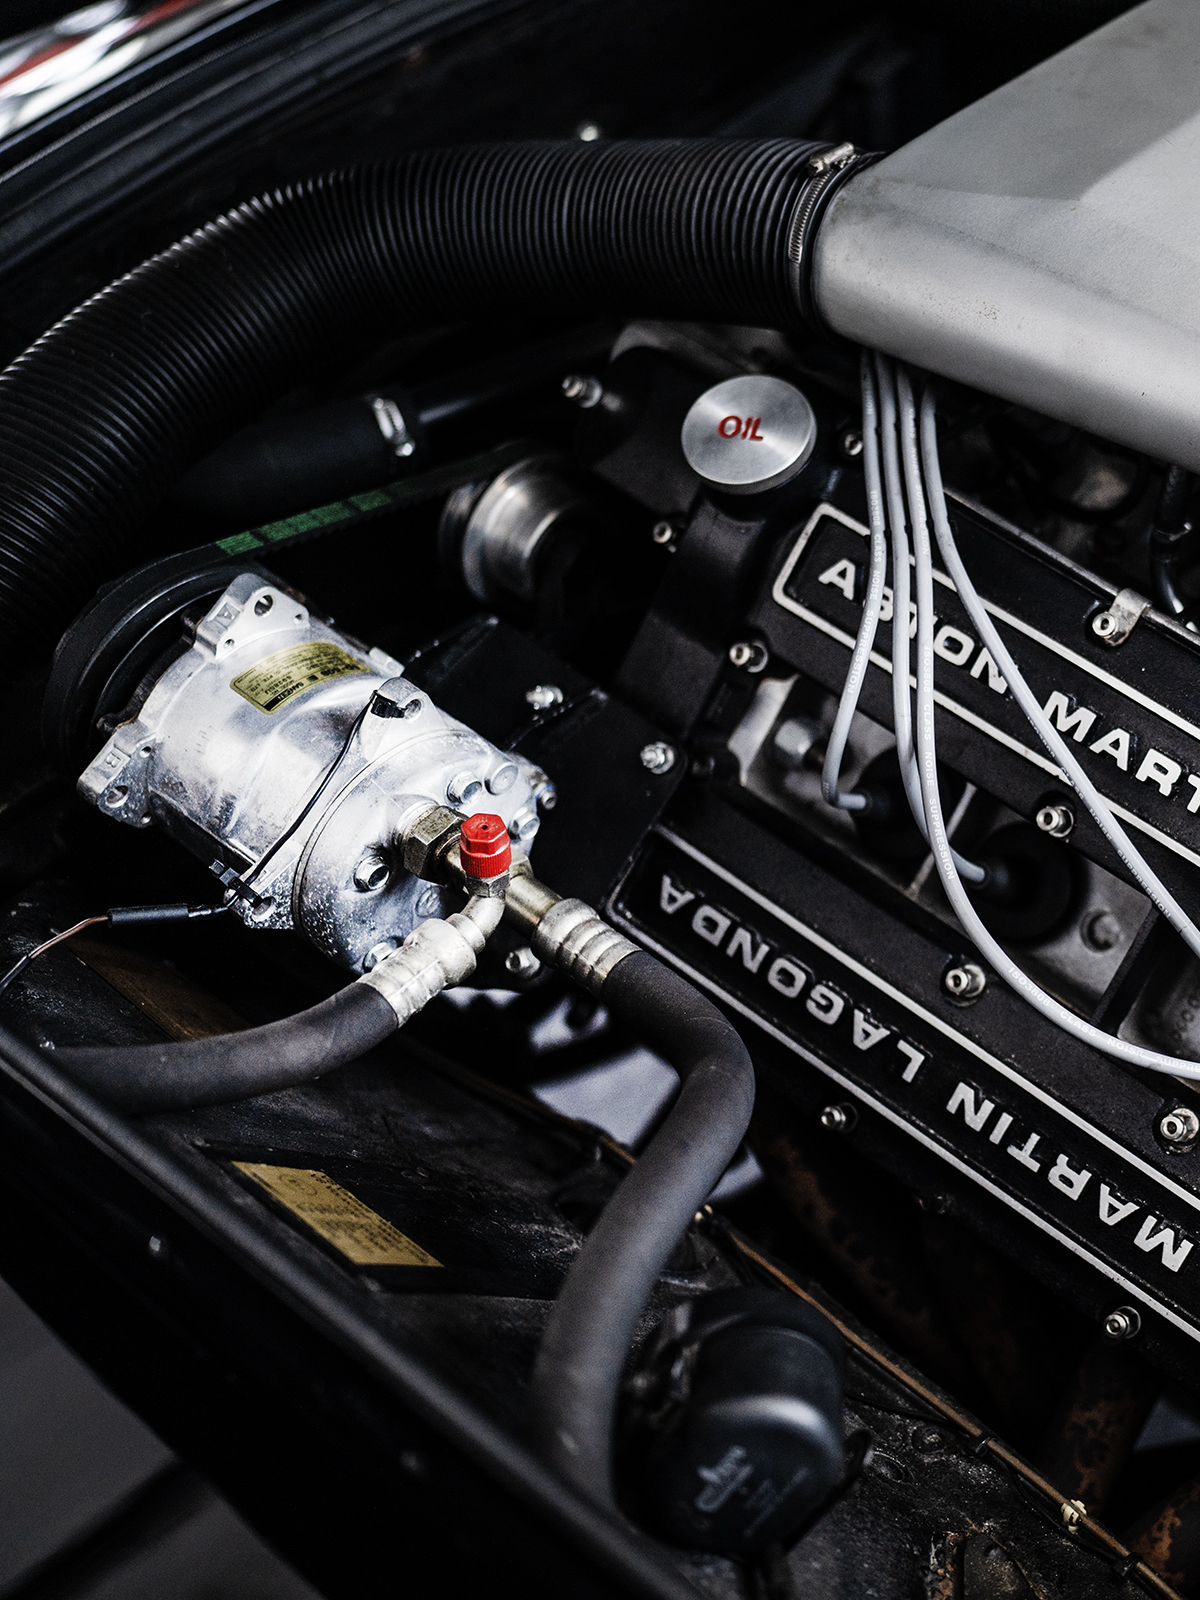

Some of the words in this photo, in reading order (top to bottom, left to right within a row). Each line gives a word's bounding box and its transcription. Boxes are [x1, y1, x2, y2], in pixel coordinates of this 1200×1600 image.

[717, 415, 764, 441] OIL
[874, 534, 882, 563] CLASS
[869, 570, 881, 600] NOISE
[846, 610, 874, 694] SUPPRESSION
[923, 647, 931, 693] ISO3808
[923, 704, 932, 741] CLASS
[924, 751, 935, 787] NOISE
[929, 798, 956, 880] SUPPRESSION
[1117, 849, 1172, 918] SUPPRESSION
[660, 875, 926, 1084] LAGONDA
[1007, 966, 1051, 1008] ISO3808
[1059, 1010, 1097, 1038] CLASS
[1106, 1037, 1144, 1058] NOISE
[946, 1081, 1194, 1273] MARTIN
